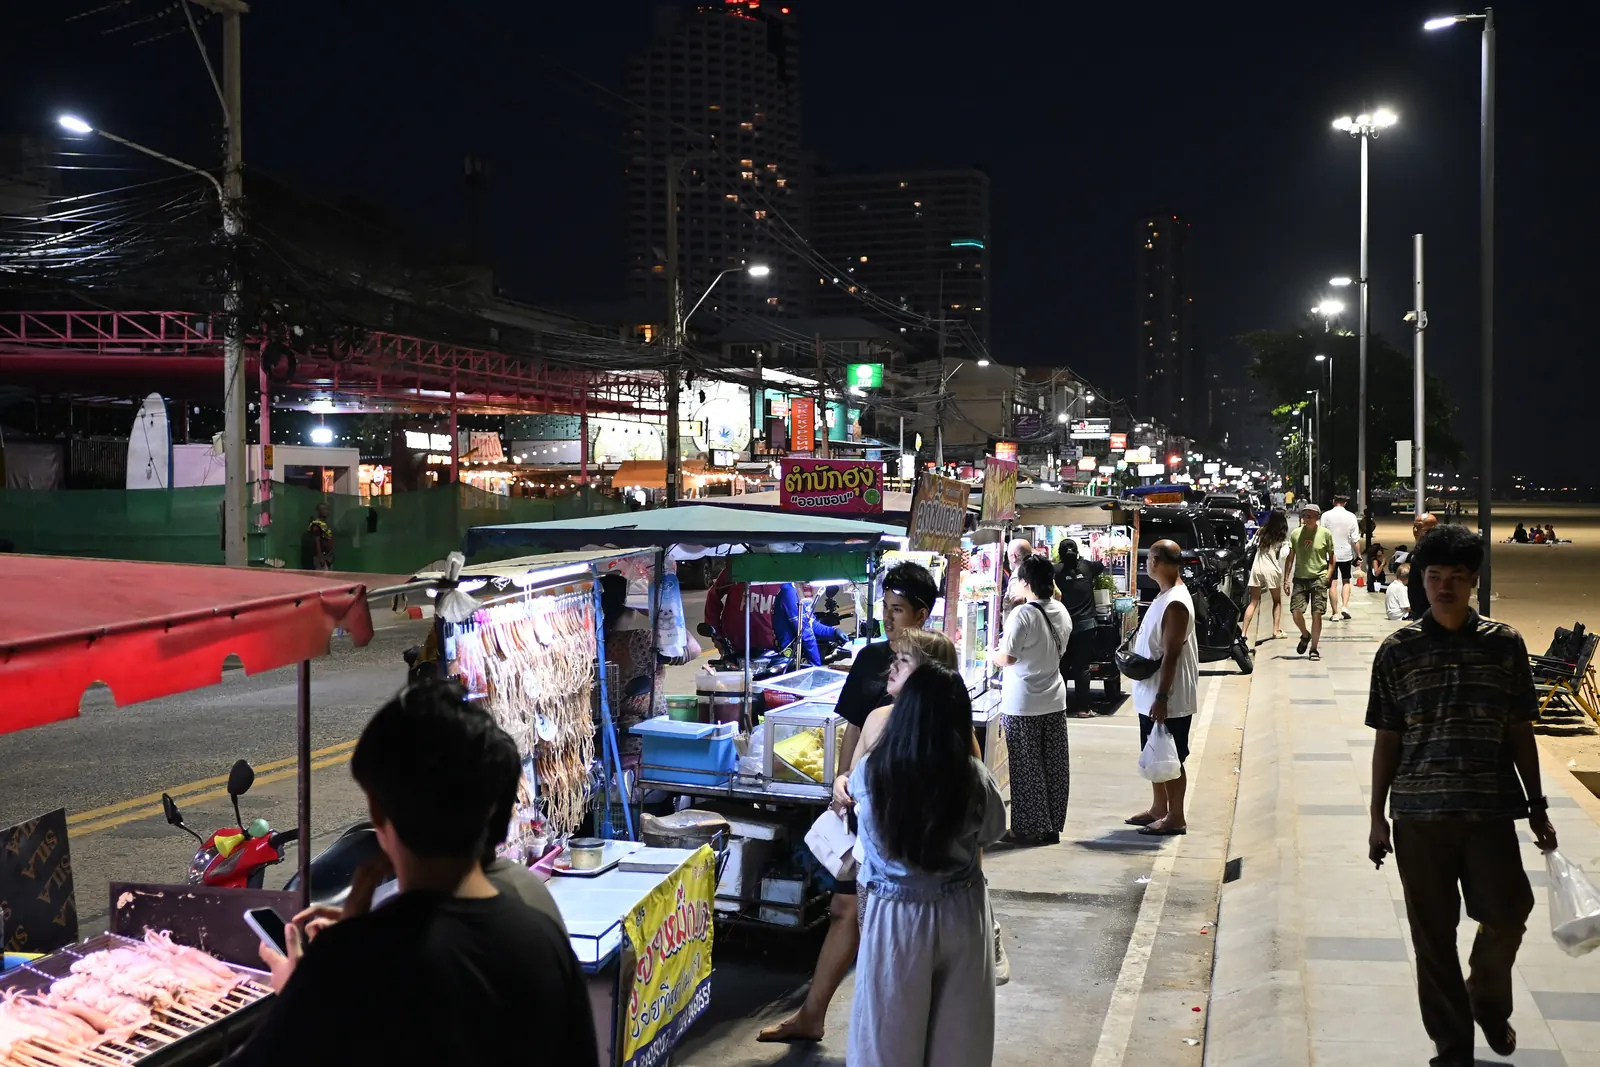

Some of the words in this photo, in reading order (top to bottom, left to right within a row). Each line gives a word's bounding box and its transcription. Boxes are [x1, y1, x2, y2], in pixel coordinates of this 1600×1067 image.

[796, 403, 809, 451] ЭКСКУРСИИ
[784, 464, 876, 497] ตำบักฮุง
[791, 492, 854, 508] "ออนซอน"
[5, 817, 41, 854] ILA
